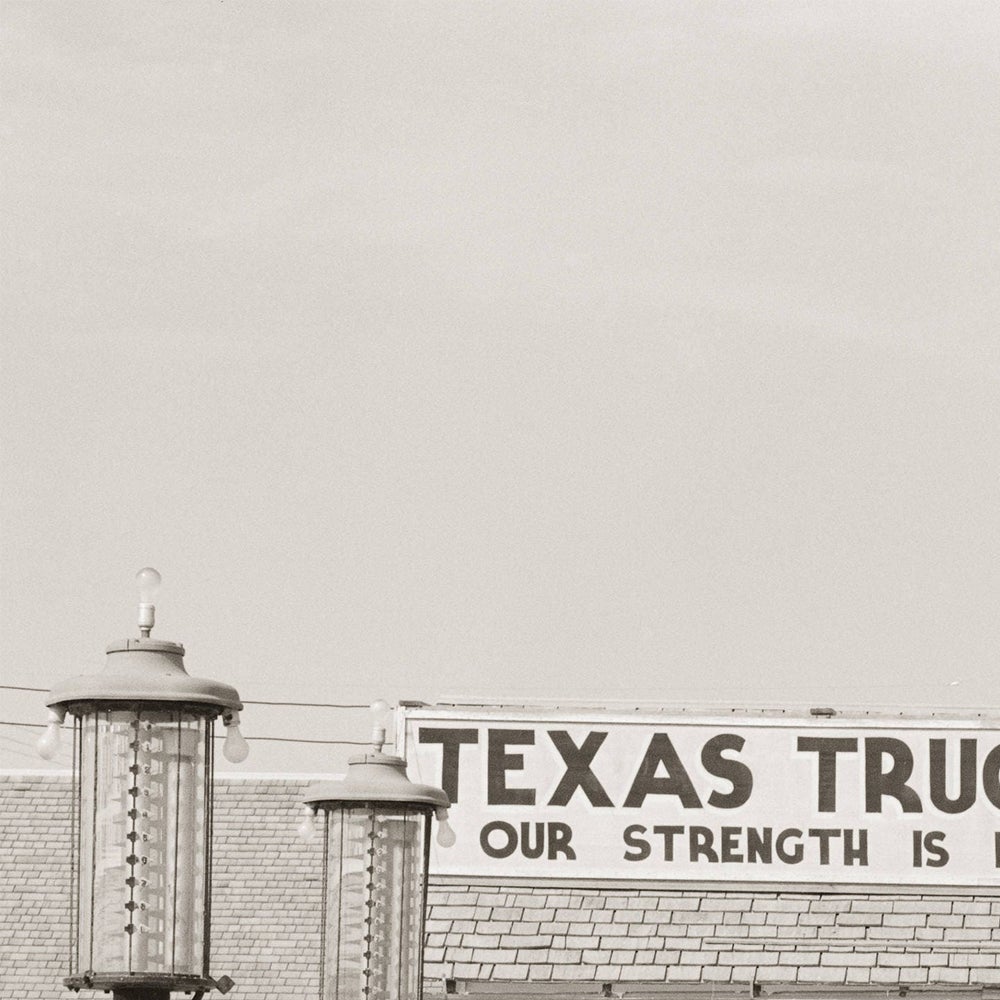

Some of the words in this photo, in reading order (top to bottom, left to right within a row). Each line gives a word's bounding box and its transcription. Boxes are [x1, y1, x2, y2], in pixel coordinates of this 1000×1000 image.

[419, 728, 753, 809] TEXAS
[480, 821, 576, 861] OUR
[624, 825, 868, 867] STRENGTH
[913, 831, 950, 868] IS
